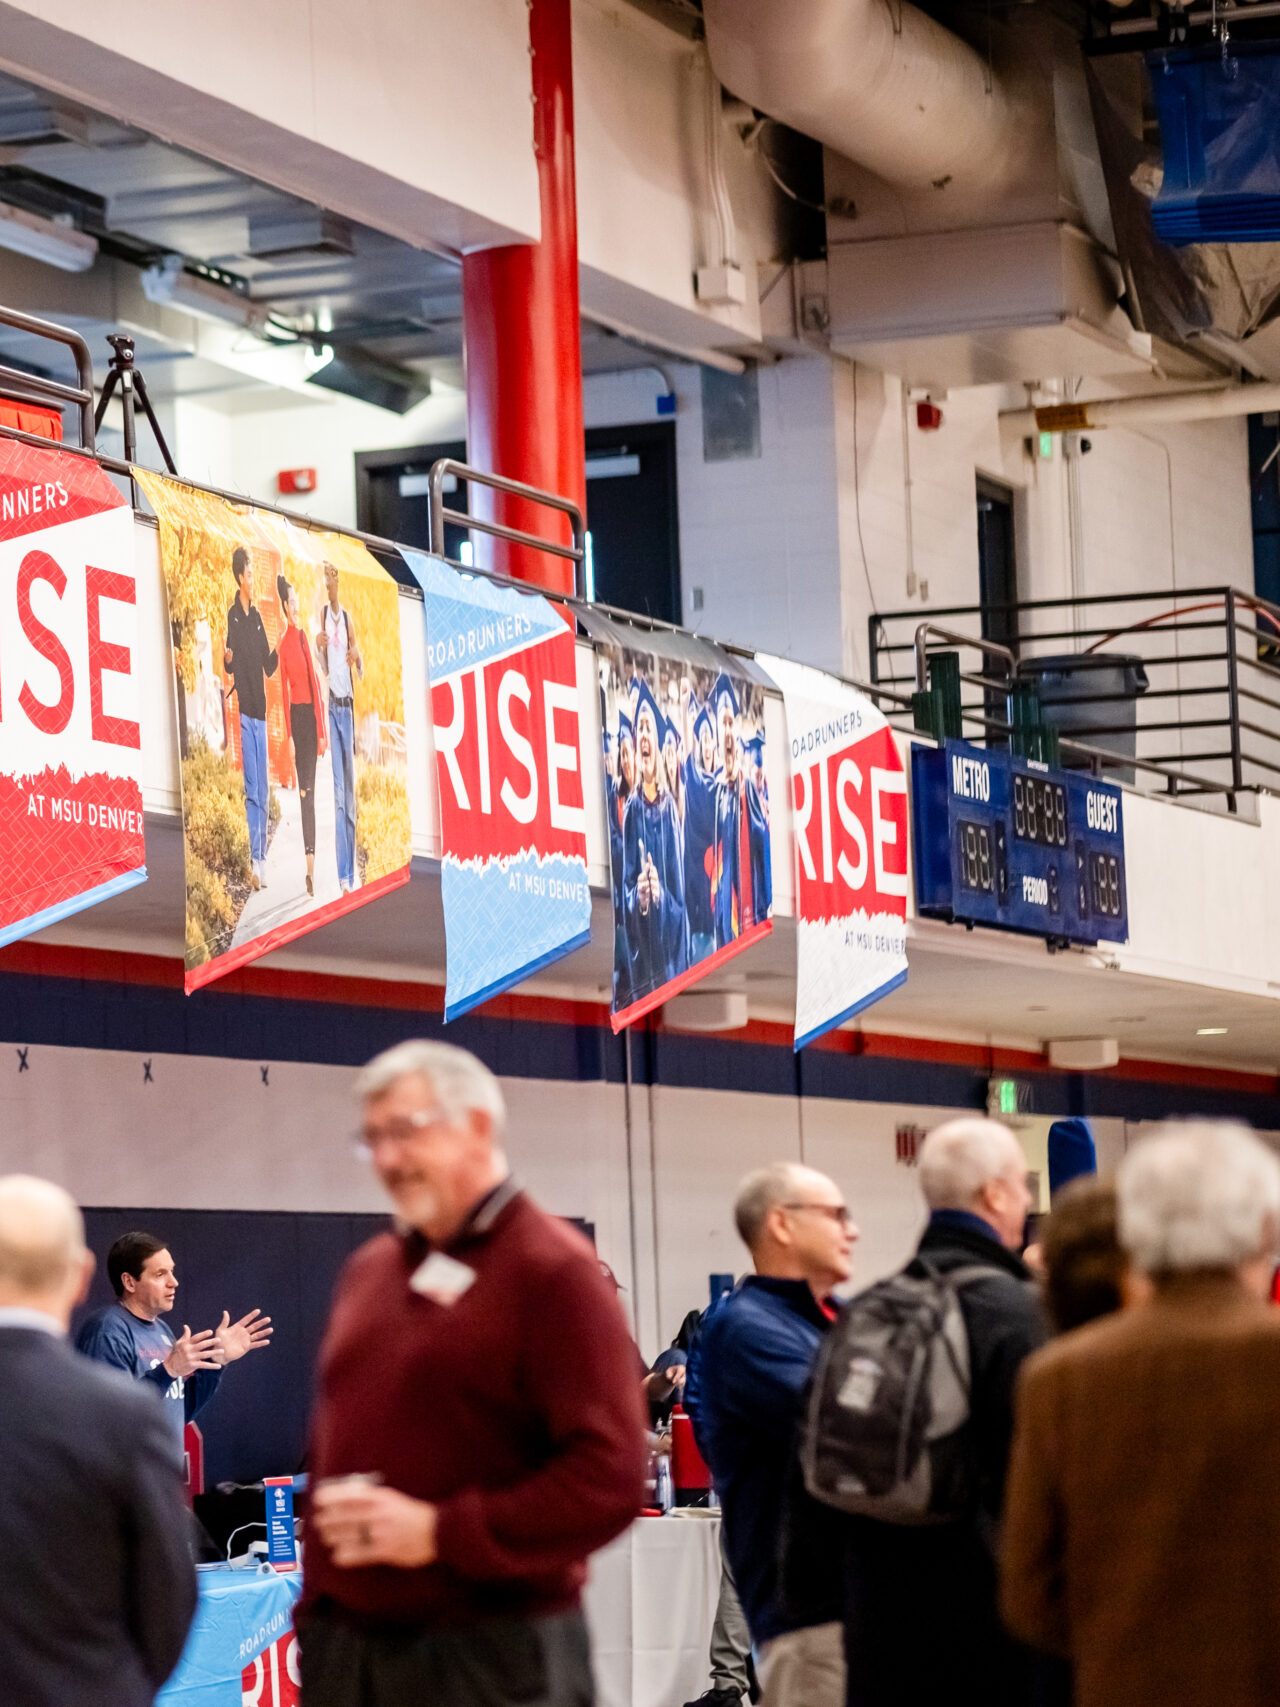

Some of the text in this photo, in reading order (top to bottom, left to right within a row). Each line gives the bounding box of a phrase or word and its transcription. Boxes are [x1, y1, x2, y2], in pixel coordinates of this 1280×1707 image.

[428, 613, 532, 667] ROADRUNNERS
[432, 667, 586, 834] RISE
[27, 793, 143, 835] AT MSU DENVER
[952, 755, 1118, 833] METRO GUEST
[794, 758, 907, 897] RISE
[509, 871, 521, 891] AT
[525, 874, 545, 897] MSU
[1023, 875, 1048, 905] PERIOD
